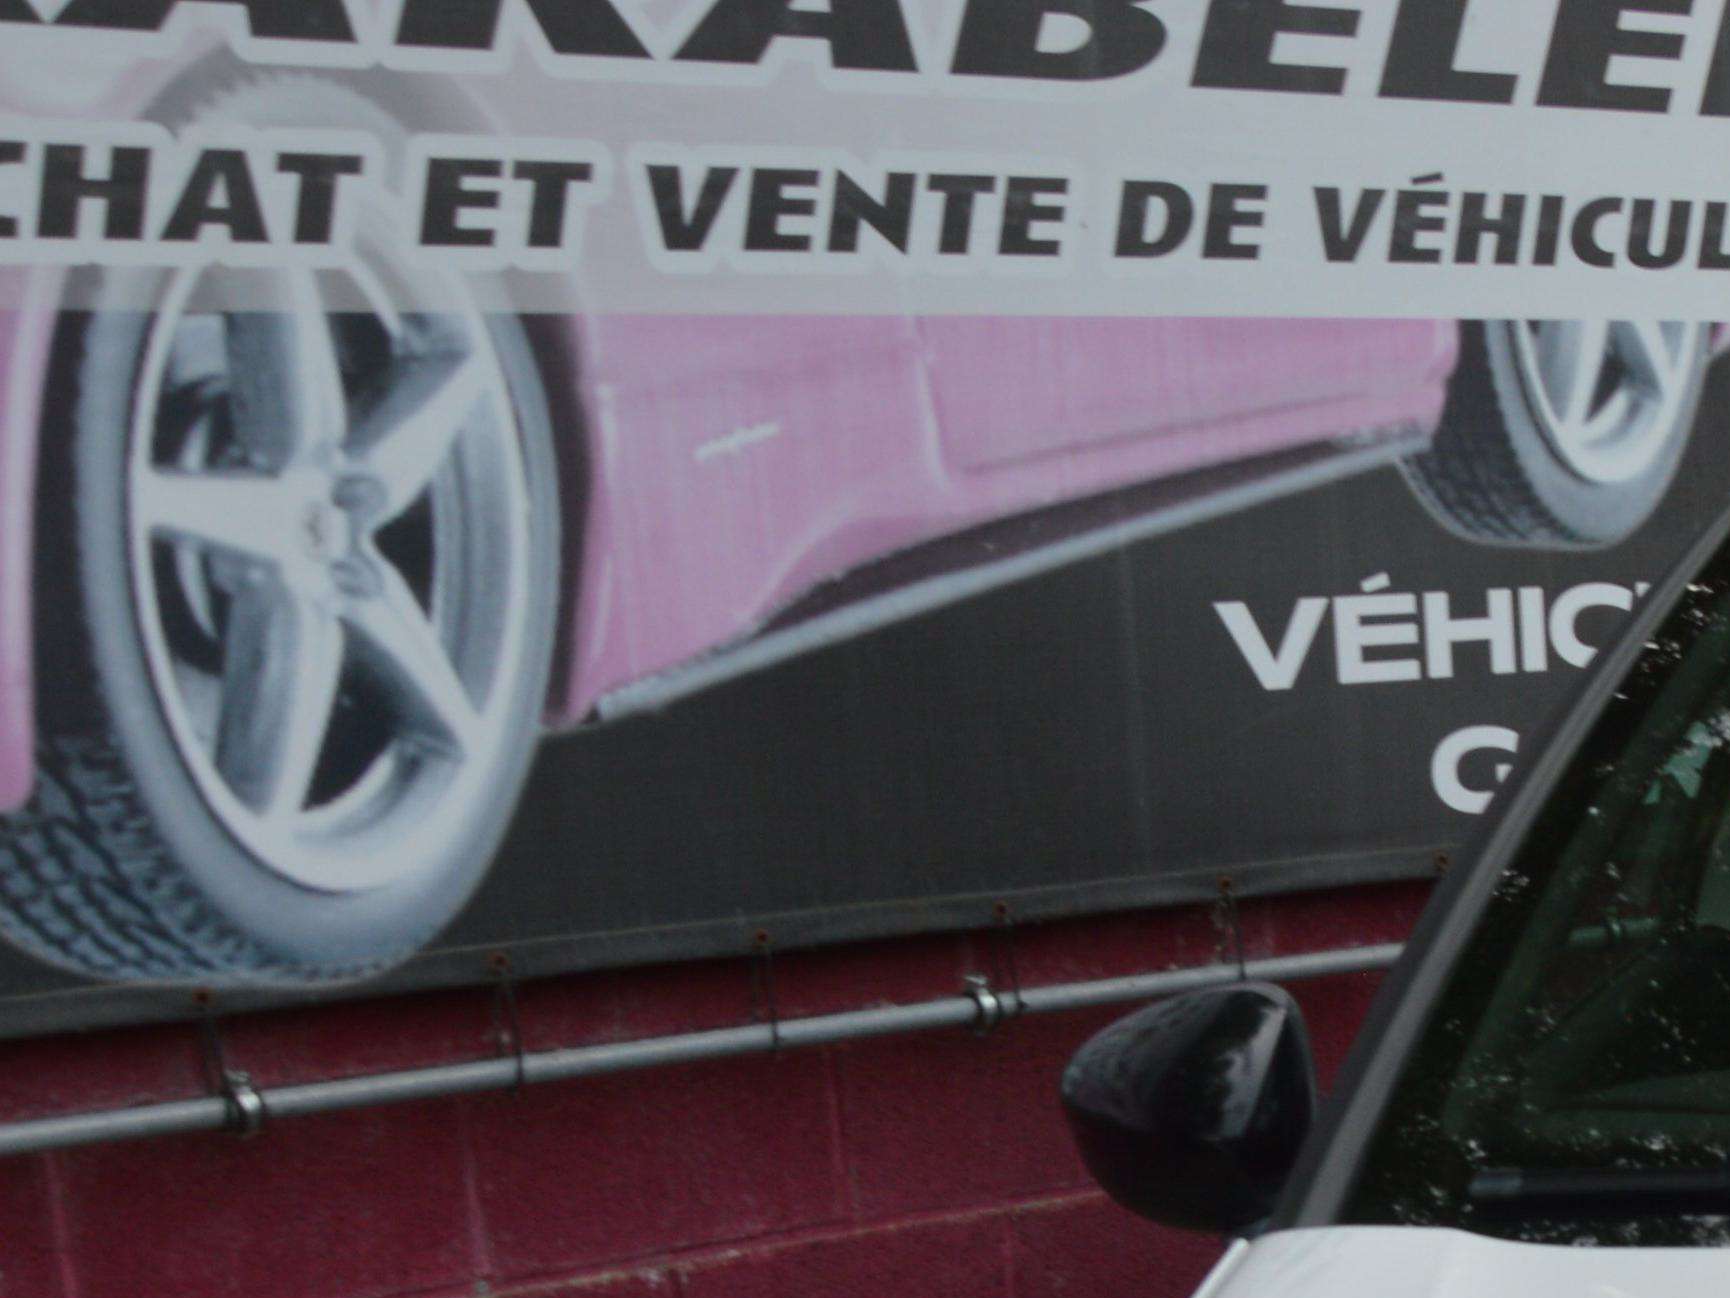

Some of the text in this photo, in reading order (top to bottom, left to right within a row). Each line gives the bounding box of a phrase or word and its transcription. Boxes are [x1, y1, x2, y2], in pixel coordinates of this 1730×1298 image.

[0, 140, 364, 244] HAT
[419, 157, 594, 248] ET
[646, 164, 1070, 256] VENTE
[1113, 179, 1269, 261] DE
